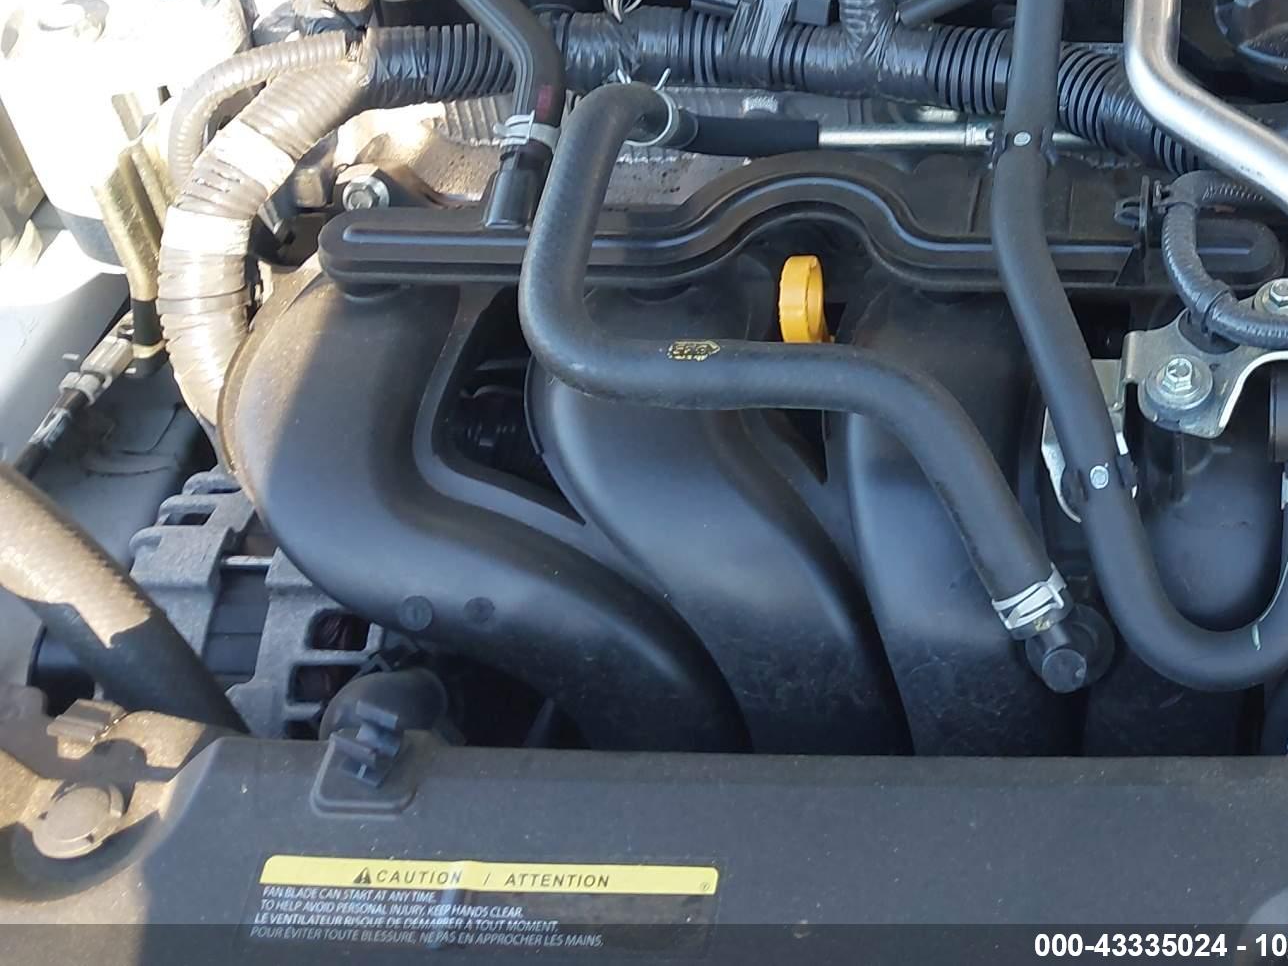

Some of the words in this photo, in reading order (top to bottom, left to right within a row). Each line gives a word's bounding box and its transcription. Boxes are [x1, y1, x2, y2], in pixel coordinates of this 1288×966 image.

[376, 868, 463, 885] CAUTION
[504, 873, 611, 889] ATTENTION
[262, 886, 284, 898] FAN
[284, 887, 317, 900] BLADE
[318, 888, 341, 900] CAN
[343, 889, 372, 901] START
[373, 890, 386, 901] AT
[387, 891, 411, 902] ANY
[260, 898, 276, 911] TO
[275, 899, 302, 912] HELP
[302, 900, 335, 913] AVOID
[336, 901, 387, 915] PERSONAL
[426, 904, 452, 917] KEEP
[451, 905, 488, 918] HANDS
[254, 912, 271, 924] LE
[270, 913, 342, 926] VENTILATEUR
[343, 915, 386, 928] RISQUE
[386, 916, 401, 928] DE
[475, 919, 505, 932] TOUT
[250, 926, 284, 939] POUR
[324, 928, 359, 941] TOUTE
[418, 931, 434, 943] NE
[432, 931, 456, 944] PAS
[457, 932, 474, 945] EN
[474, 933, 543, 946] APPROCHER
